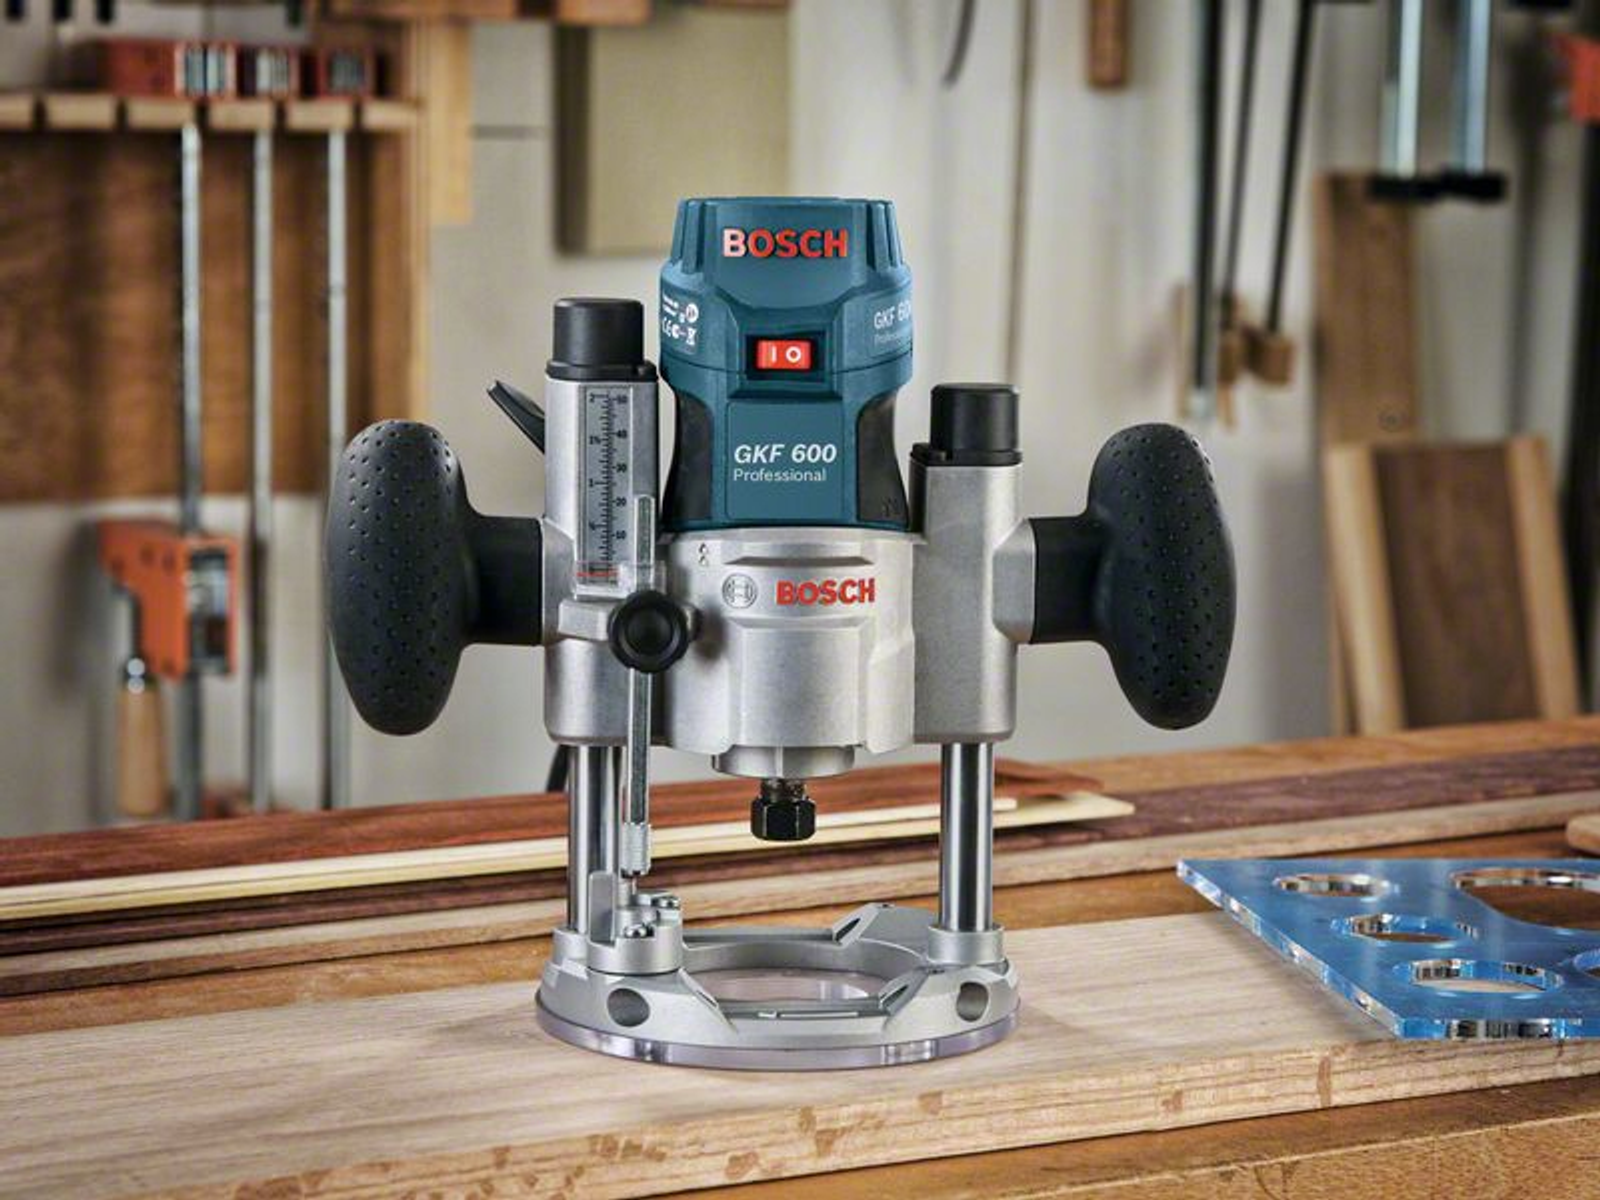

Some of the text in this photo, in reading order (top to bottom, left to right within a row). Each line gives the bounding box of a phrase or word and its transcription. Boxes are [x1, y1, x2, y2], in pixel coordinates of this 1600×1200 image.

[722, 228, 848, 258] BOSCH
[874, 306, 895, 329] GKF
[734, 443, 837, 463] GKF 600
[733, 468, 827, 481] Professional
[776, 578, 876, 606] BOSCH
